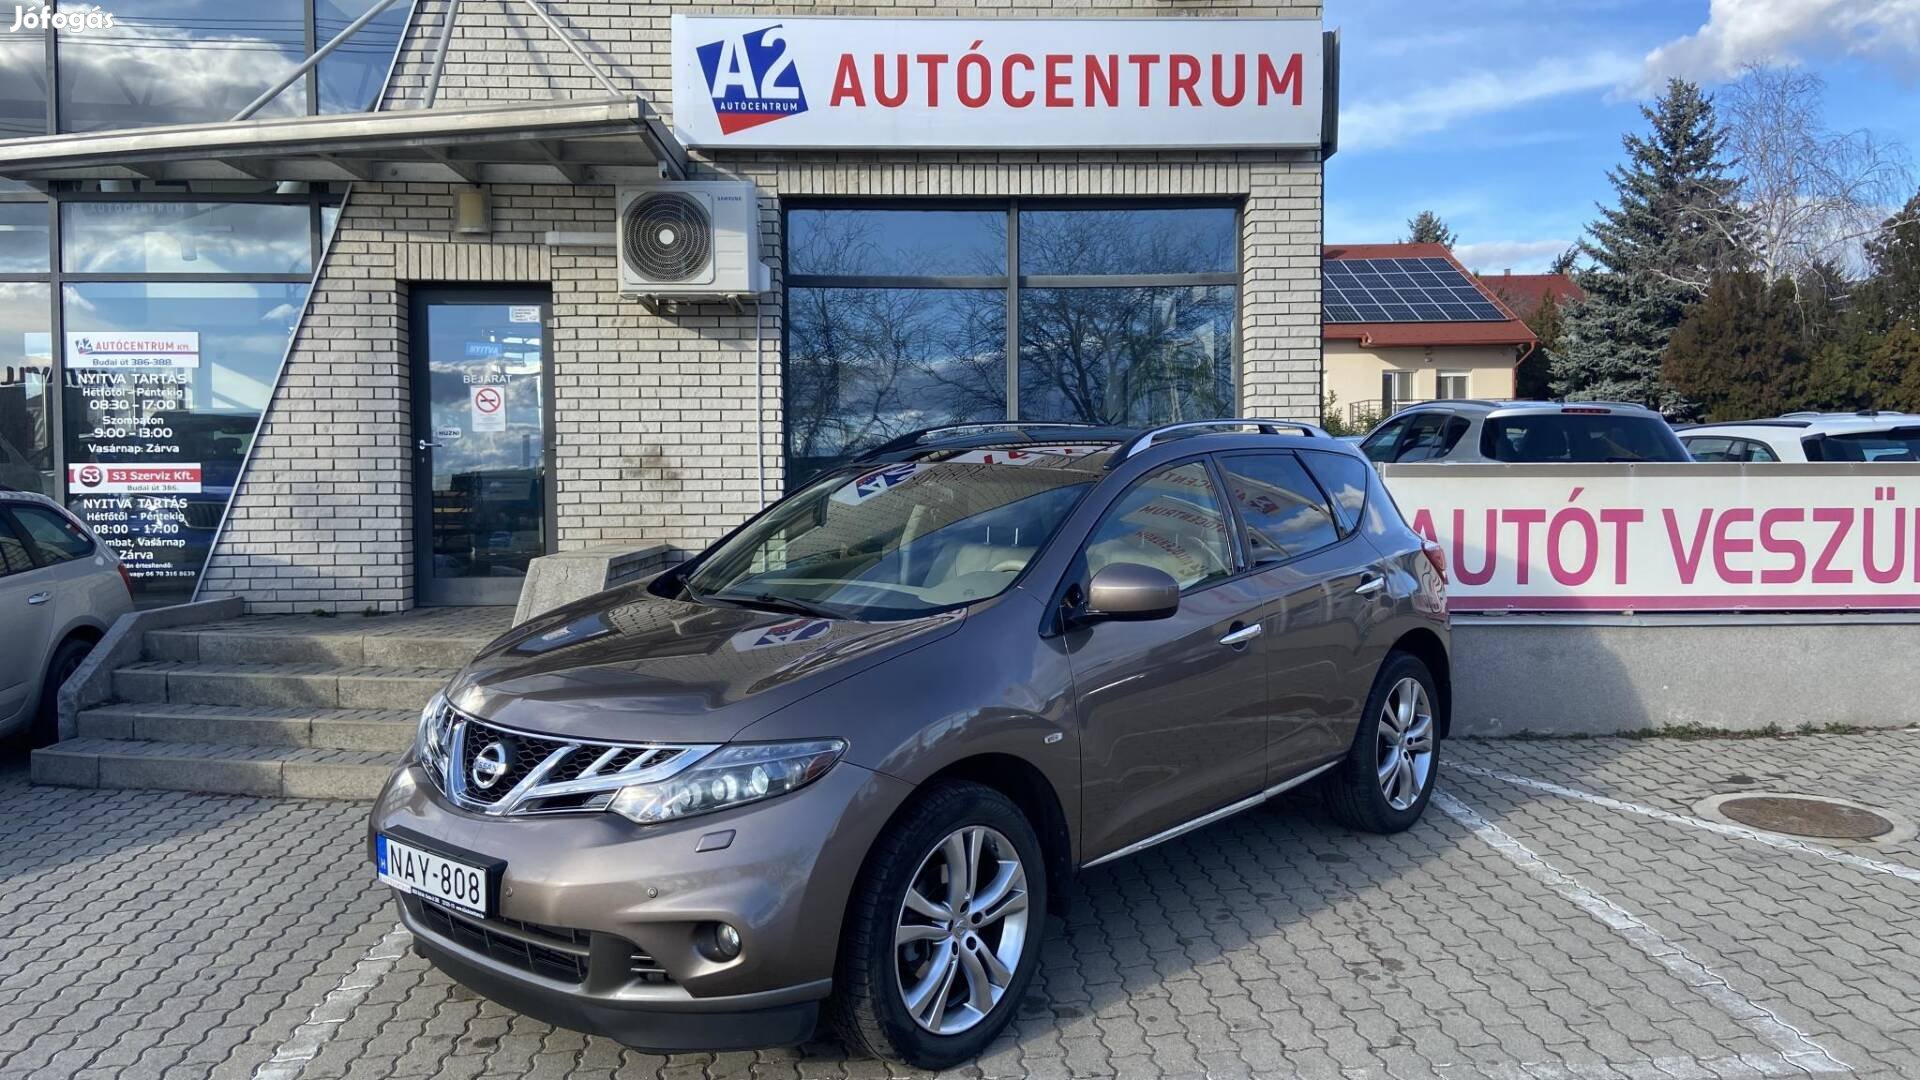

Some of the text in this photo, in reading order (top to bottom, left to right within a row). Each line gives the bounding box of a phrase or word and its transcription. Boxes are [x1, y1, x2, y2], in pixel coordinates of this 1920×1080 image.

[711, 26, 800, 98] A2
[829, 39, 1303, 108] AUTÓCENTRUM
[720, 101, 798, 111] AUTÓCENTRUM
[78, 374, 126, 384] NYITVA
[90, 400, 129, 410] 08:30
[142, 400, 176, 410] 17:00
[103, 416, 164, 425] Szombaton
[94, 428, 125, 438] 9:00
[139, 428, 172, 438] 13:00
[88, 443, 179, 454] Vasárnap: Zárva
[82, 468, 100, 483] S3
[112, 471, 194, 480] S3 Szerviz Kft.
[83, 495, 188, 509] NYITVA TARTÁS
[141, 512, 184, 523] Péntekig
[93, 525, 128, 534] 08:00
[144, 525, 179, 534] 17:00
[1662, 487, 1920, 585] VESZÜ
[106, 538, 186, 548] mbat, Vasárnap
[120, 550, 154, 560] Zárva
[391, 845, 480, 905] NAY-808
